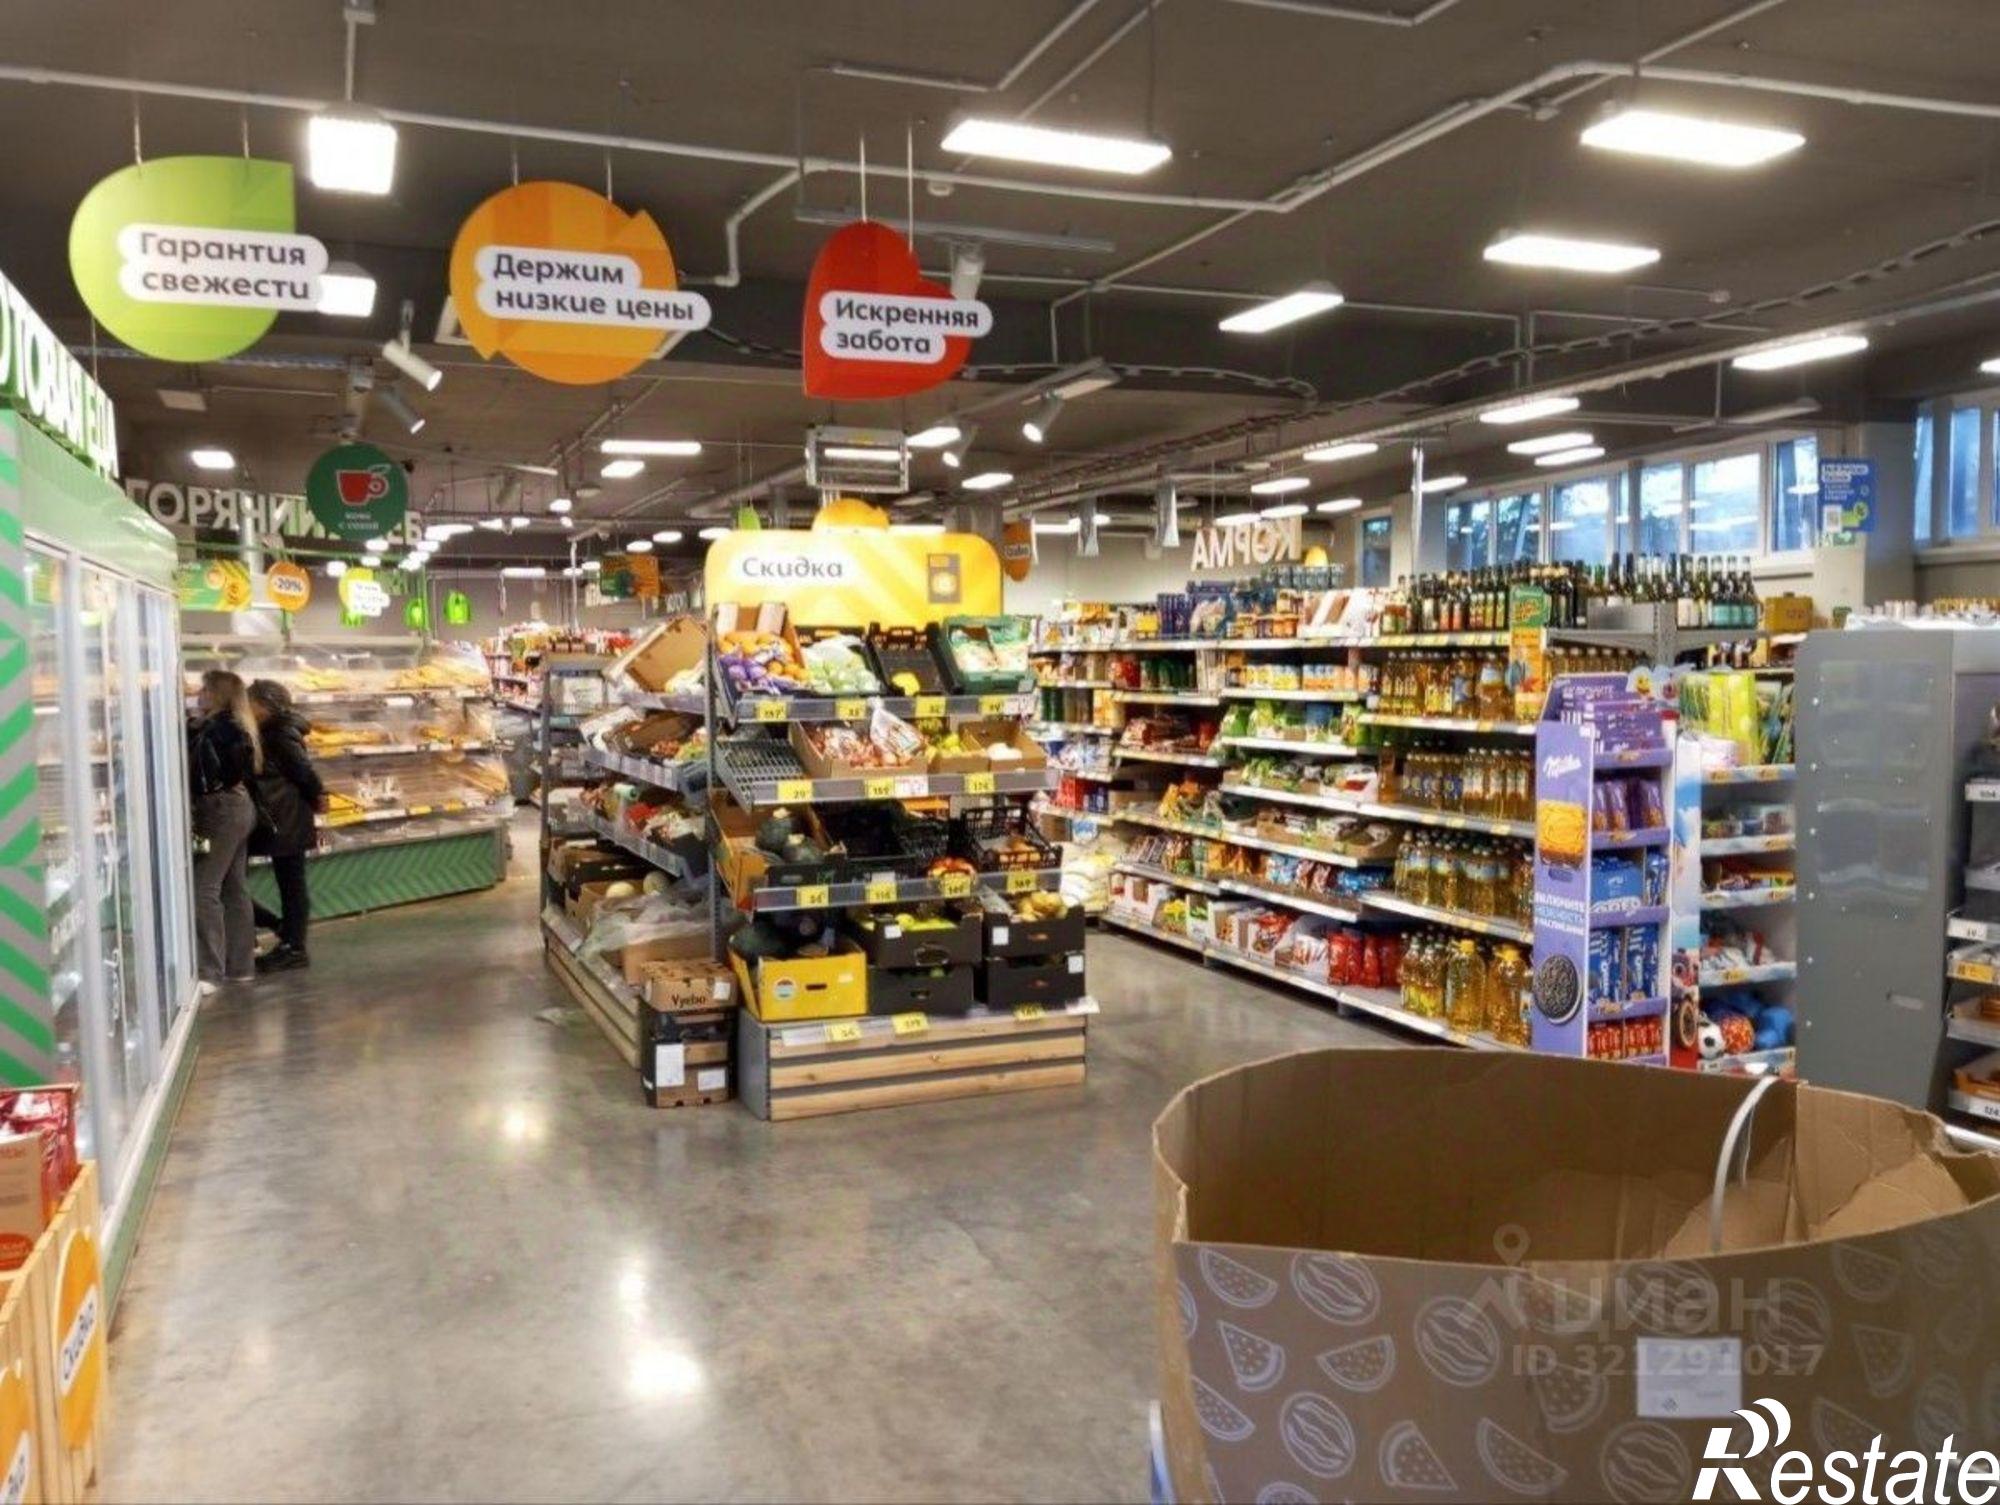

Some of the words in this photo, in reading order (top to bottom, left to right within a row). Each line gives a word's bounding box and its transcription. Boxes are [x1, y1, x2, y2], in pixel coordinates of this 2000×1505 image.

[140, 232, 306, 265] Гарантия
[493, 253, 624, 284] Держим
[142, 271, 310, 300] свежести
[496, 290, 606, 314] низкие
[616, 299, 694, 320] цены
[835, 298, 979, 328] Искренняя
[837, 330, 931, 354] забота
[742, 557, 843, 578] Скидка
